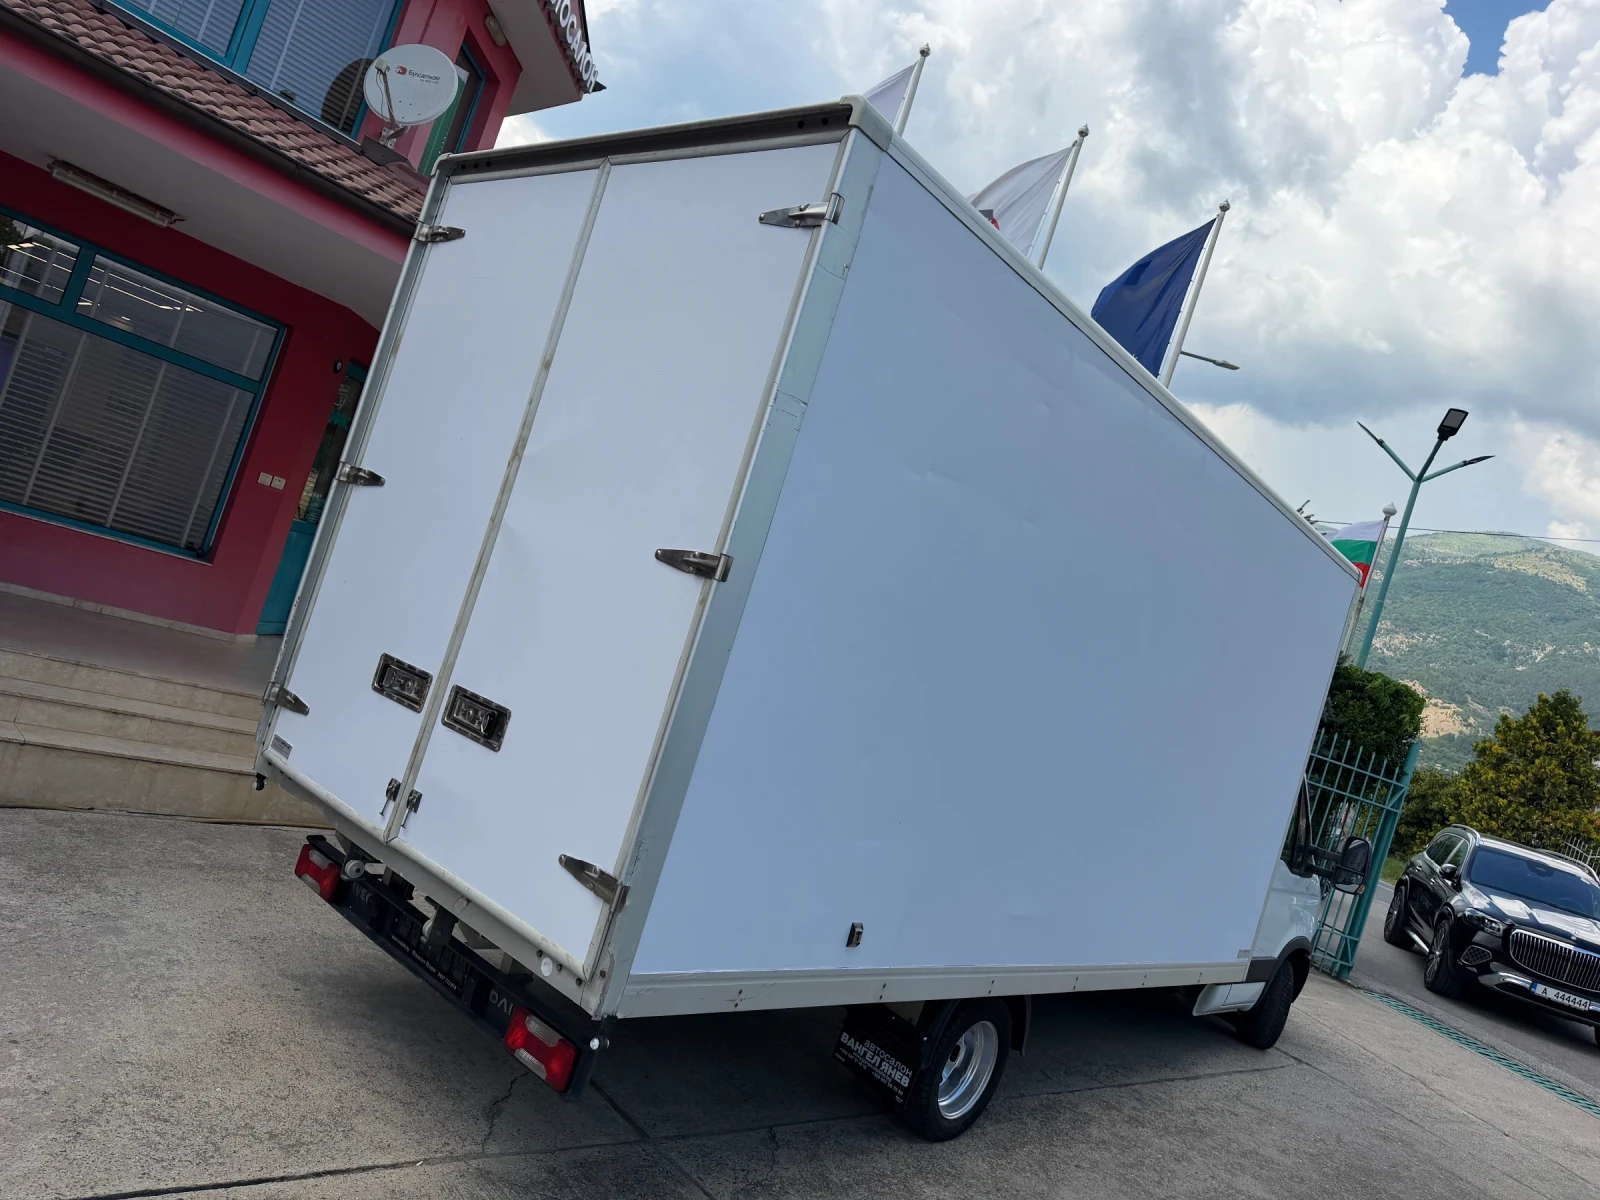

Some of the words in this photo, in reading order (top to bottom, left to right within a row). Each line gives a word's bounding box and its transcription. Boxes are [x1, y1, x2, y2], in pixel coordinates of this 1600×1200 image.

[550, 0, 599, 94] ОСАЛОН
[1541, 987, 1548, 996] A
[1553, 991, 1589, 1009] 444444
[840, 1031, 881, 1068] ВАНГЕЛ
[879, 1061, 910, 1088] ЯНЕВ
[864, 1039, 913, 1078] автосалон
